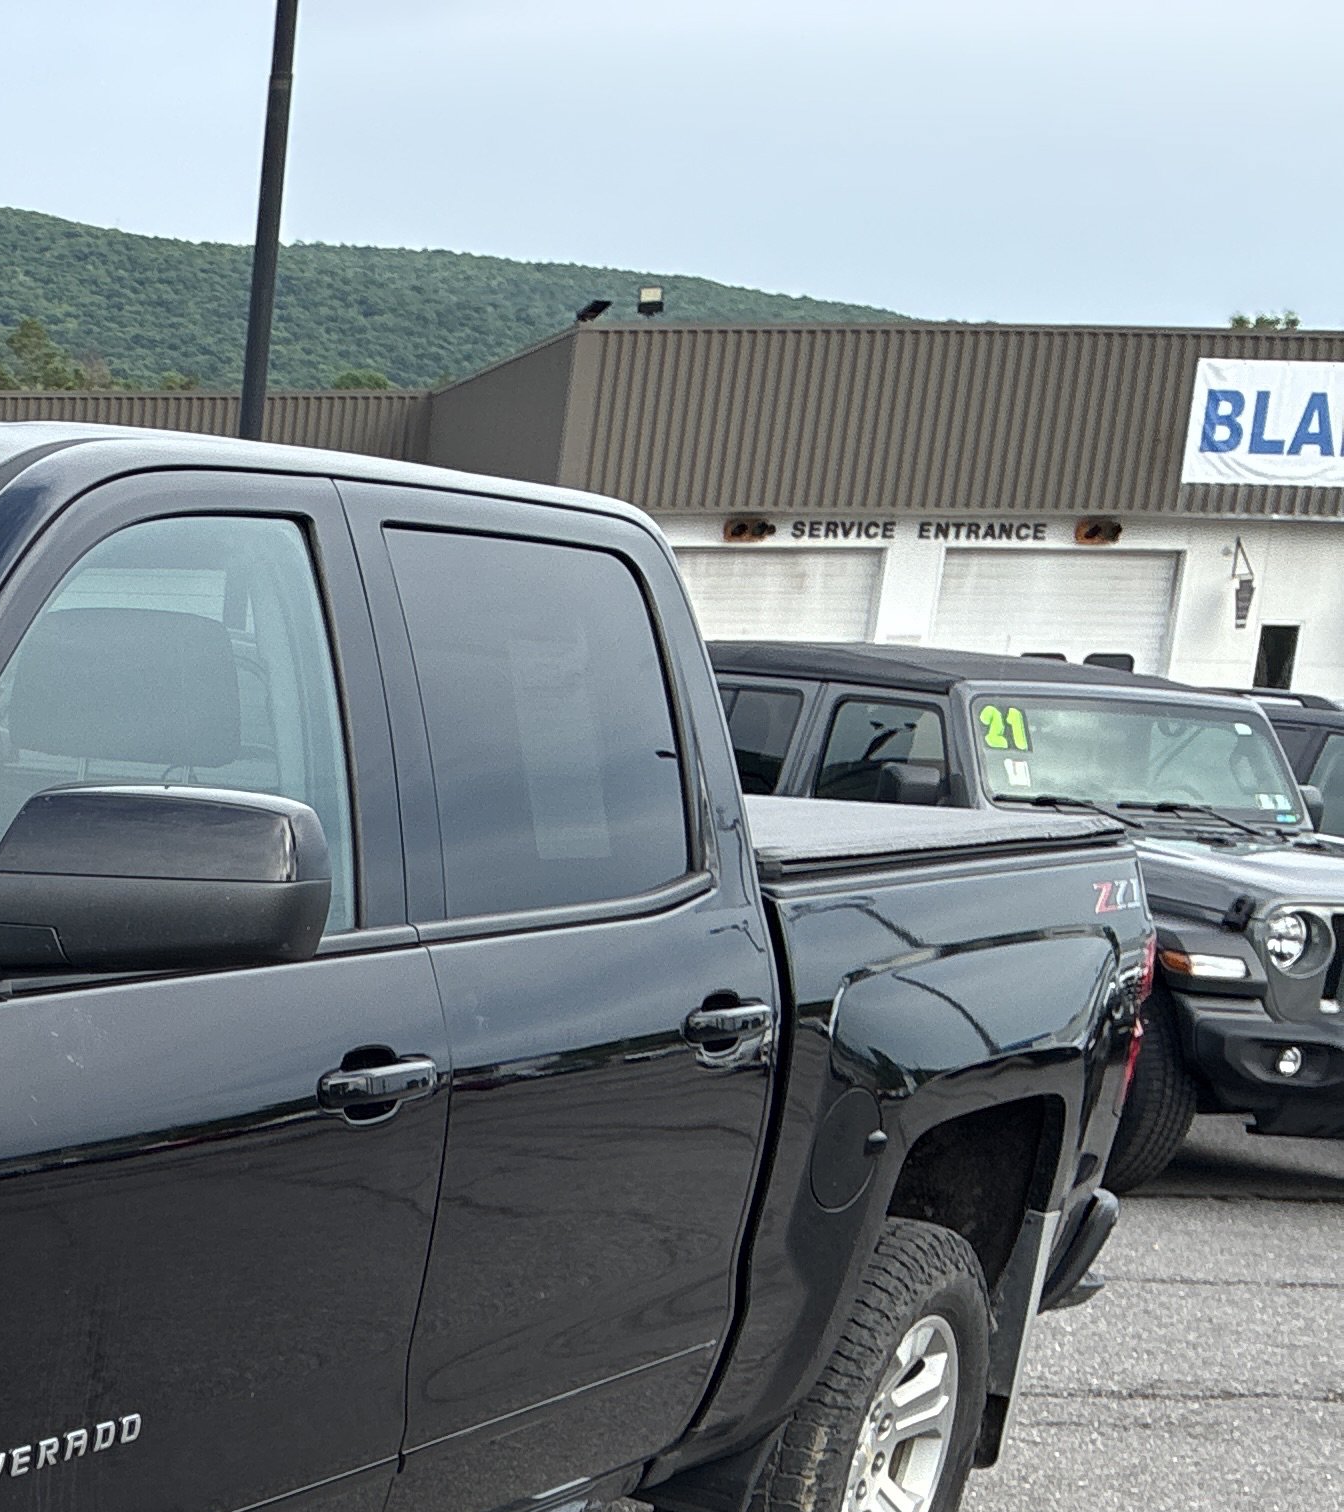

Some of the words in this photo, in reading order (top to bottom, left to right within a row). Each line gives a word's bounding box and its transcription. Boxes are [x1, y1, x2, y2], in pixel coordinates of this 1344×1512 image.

[1199, 388, 1344, 457] BLA
[791, 520, 897, 540] SERVICE
[918, 521, 1047, 541] ENTRANCE
[979, 705, 1029, 751] 21
[1092, 877, 1142, 915] Z71
